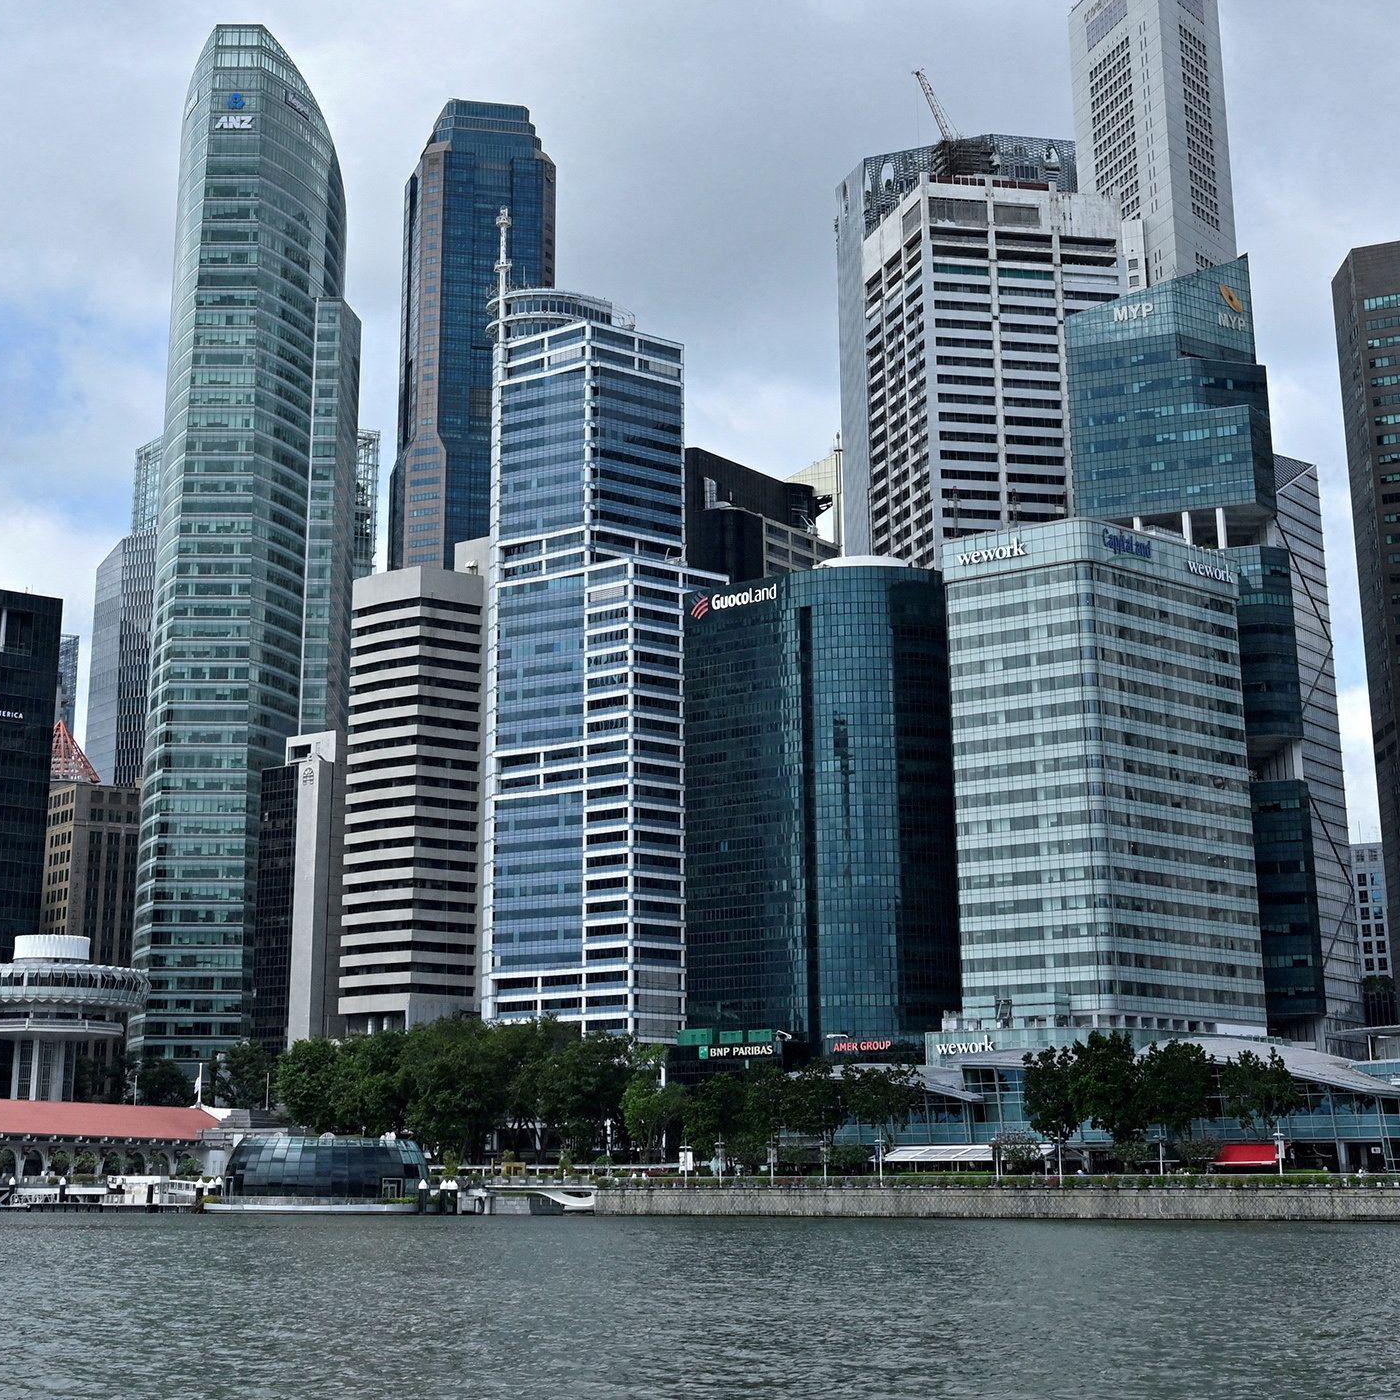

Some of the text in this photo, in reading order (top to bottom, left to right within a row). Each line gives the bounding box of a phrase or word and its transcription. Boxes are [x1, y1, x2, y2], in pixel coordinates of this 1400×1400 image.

[215, 116, 253, 129] ANZ
[1113, 303, 1154, 321] MYP
[1218, 312, 1246, 331] MYP
[957, 537, 1027, 565] wework
[1187, 560, 1233, 583] wework
[710, 1045, 773, 1057] BNP PARIBAS
[833, 1040, 891, 1052] AMER GROUP
[936, 1034, 994, 1055] wework
